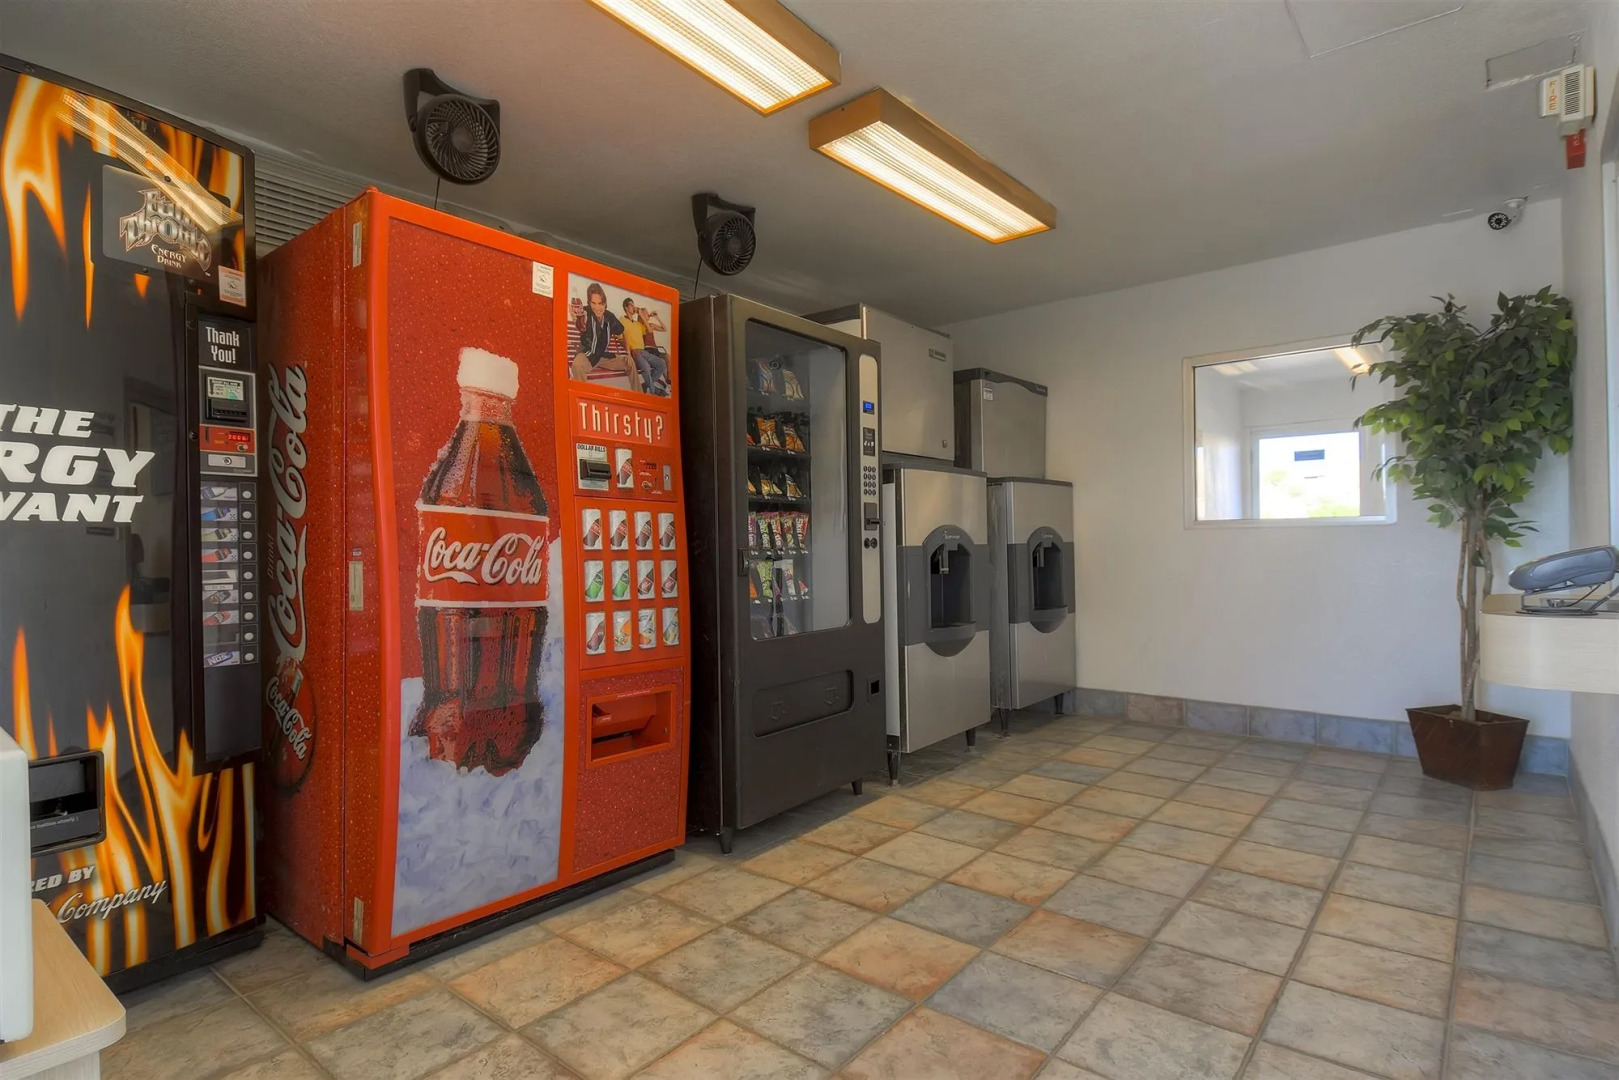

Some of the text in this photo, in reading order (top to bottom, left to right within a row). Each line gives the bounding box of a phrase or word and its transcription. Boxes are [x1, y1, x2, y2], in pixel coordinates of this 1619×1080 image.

[151, 243, 187, 264] ENERGY
[205, 326, 240, 348] Thank
[210, 344, 237, 364] You!
[0, 403, 96, 438] THE
[579, 402, 664, 444] Thirsty?
[268, 364, 308, 663] Coca-Cola
[422, 525, 546, 586] Coca-Cola
[31, 864, 96, 893] ED BY
[56, 880, 168, 924] Company
